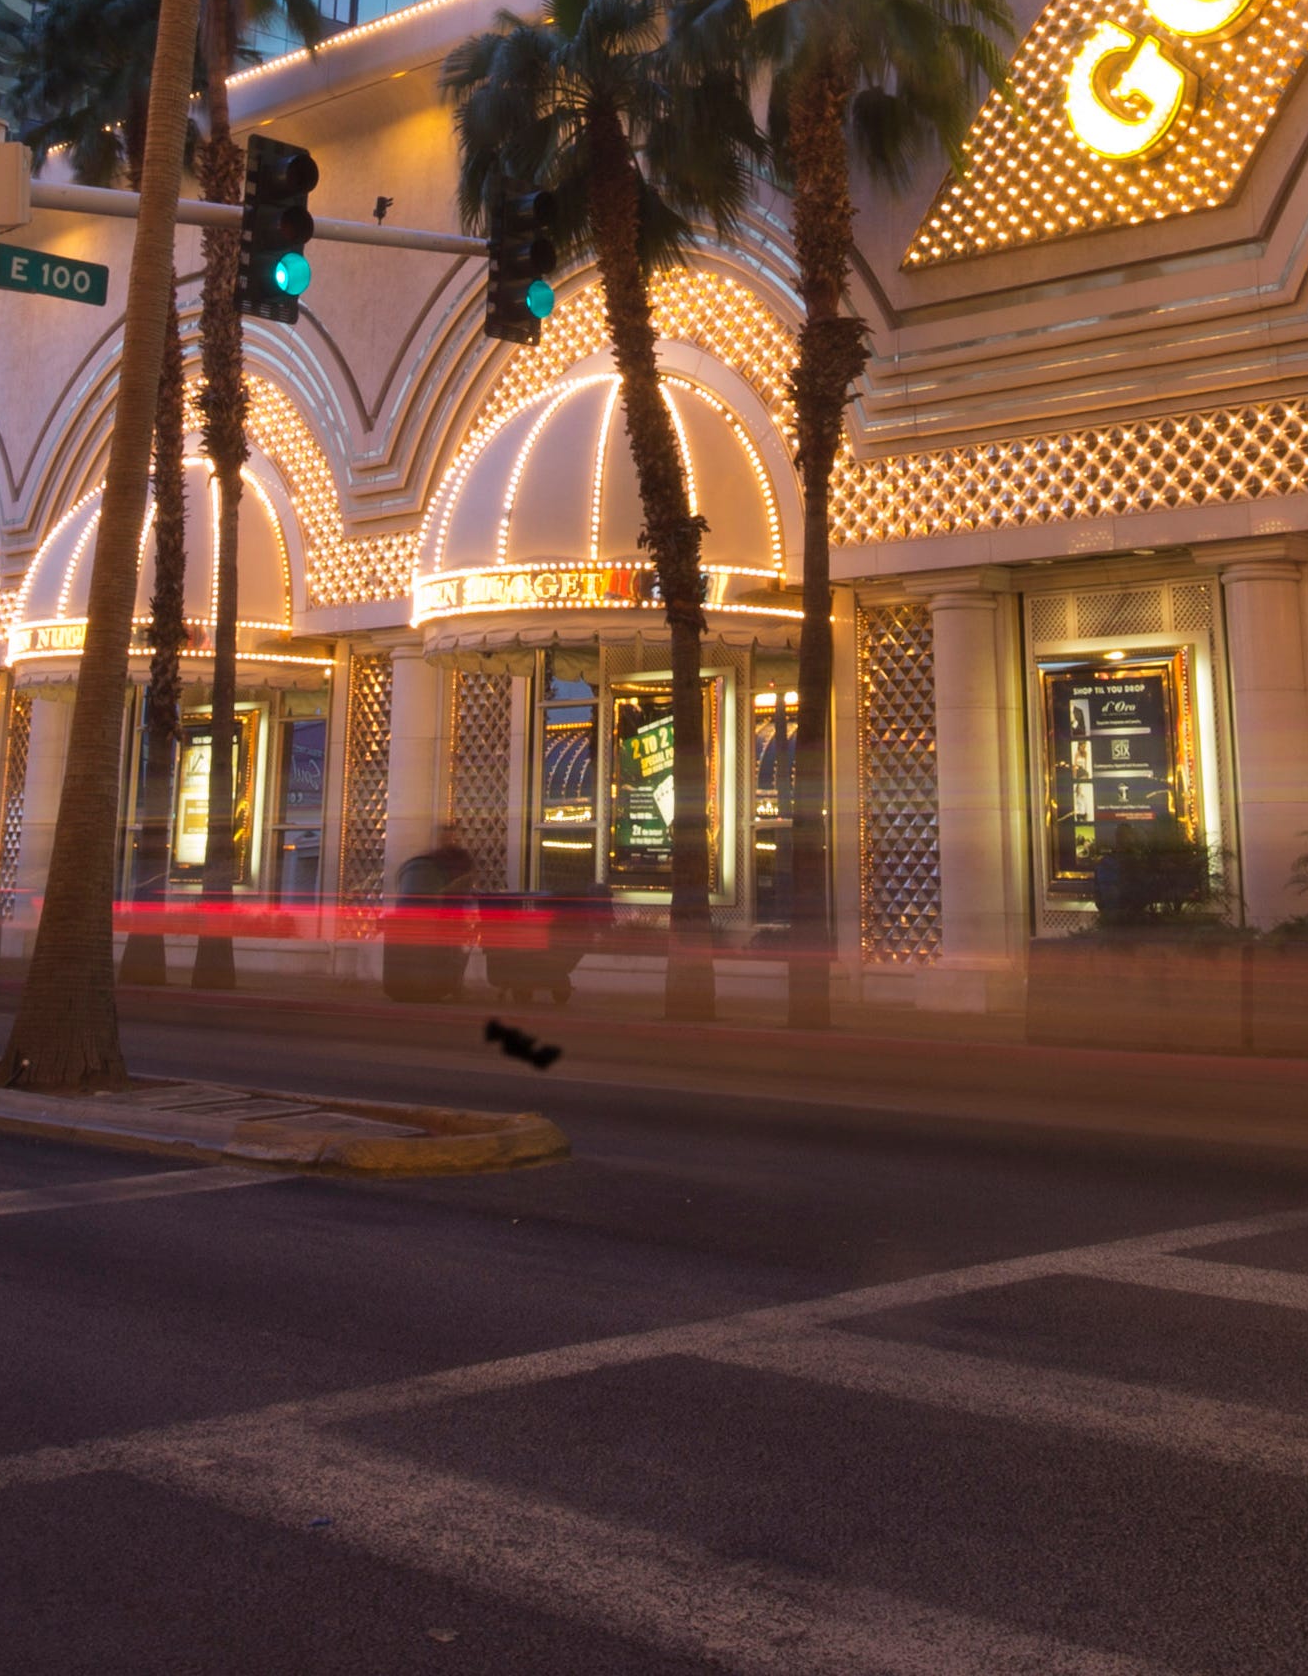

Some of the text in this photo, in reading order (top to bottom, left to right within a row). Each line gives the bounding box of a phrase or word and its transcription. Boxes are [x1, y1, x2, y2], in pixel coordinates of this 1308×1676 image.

[10, 256, 91, 294] E 100
[1073, 687, 1093, 696] SHOP
[1107, 685, 1123, 694] YOU
[1125, 684, 1146, 693] DROP
